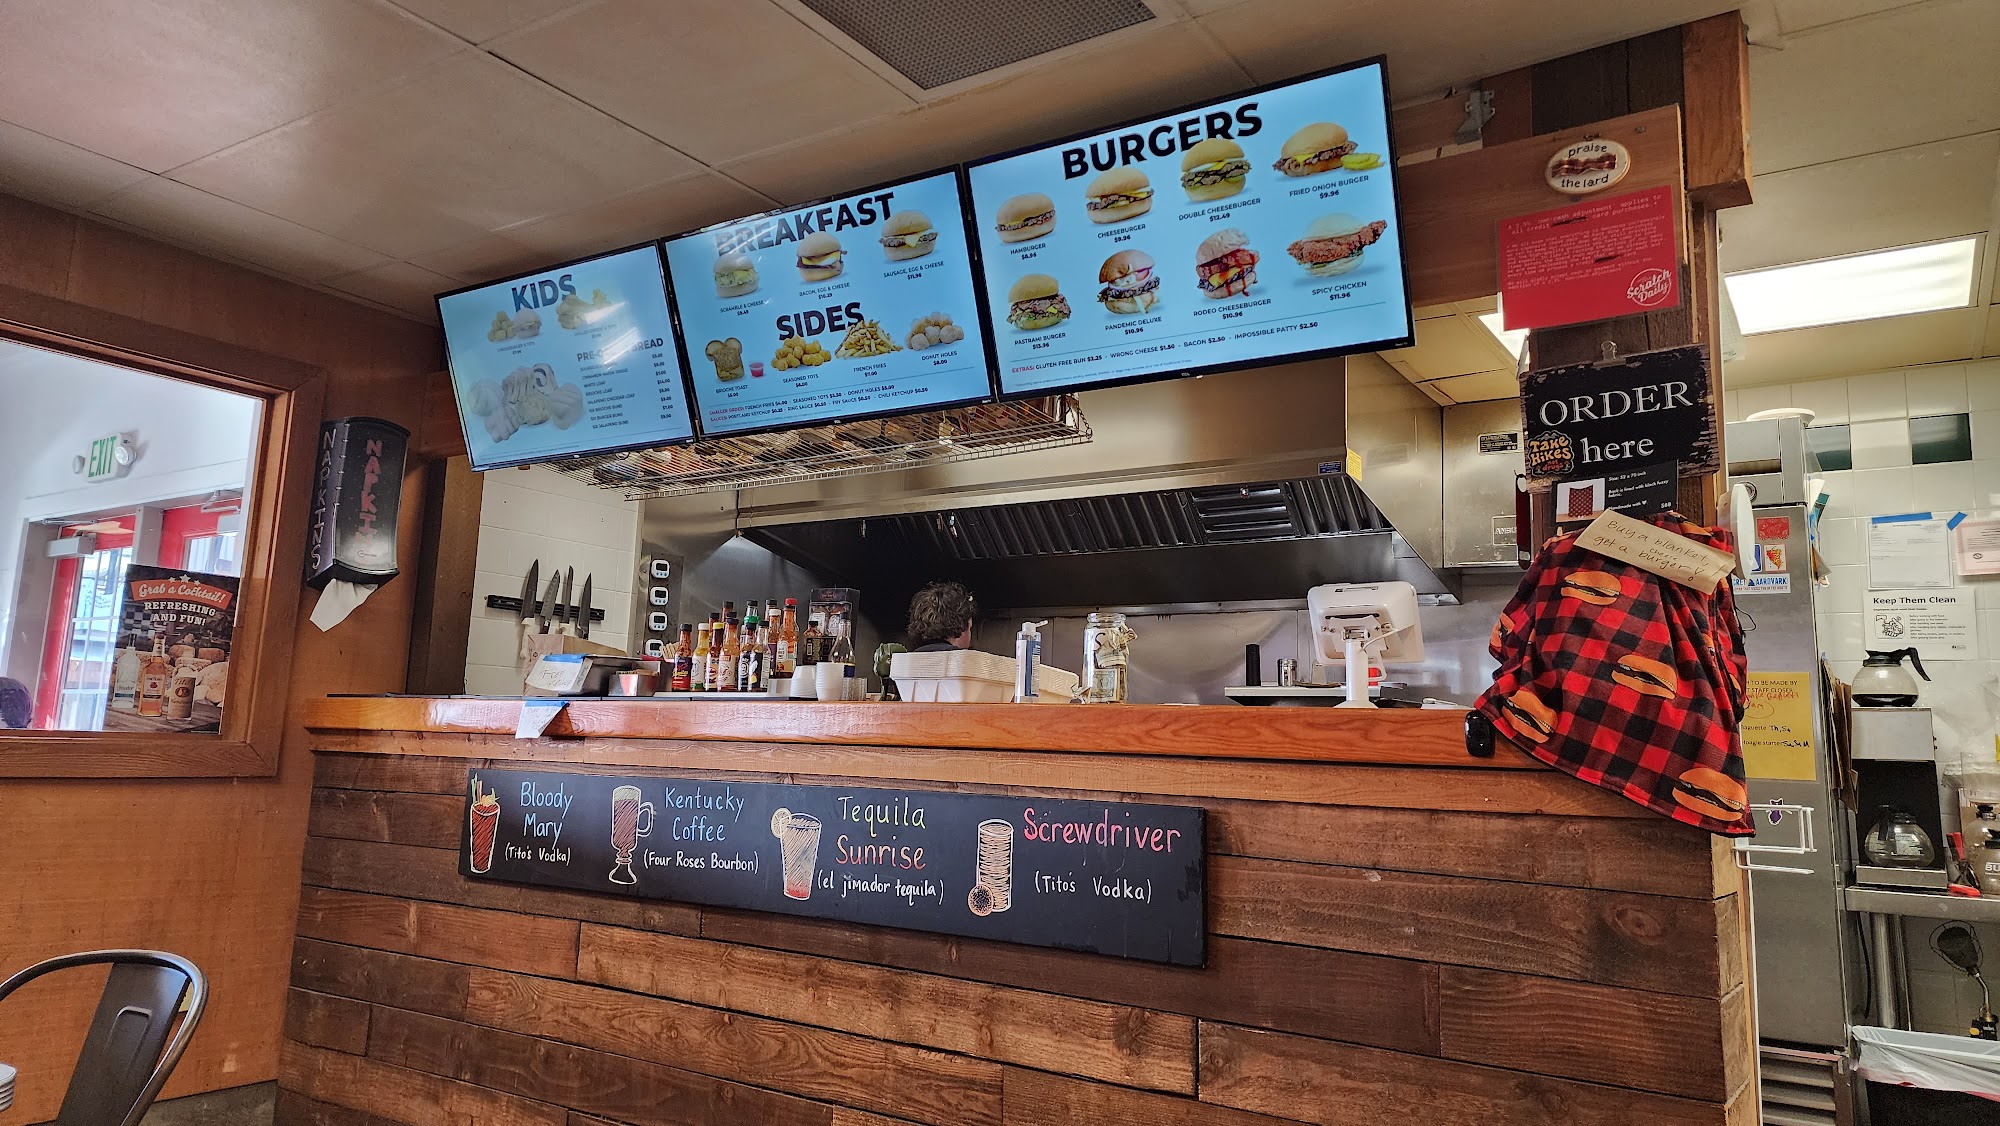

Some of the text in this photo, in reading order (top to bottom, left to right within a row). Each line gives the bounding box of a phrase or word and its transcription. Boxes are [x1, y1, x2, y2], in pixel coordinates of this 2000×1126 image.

[1062, 102, 1263, 180] BURGERS
[1568, 144, 1608, 158] praise
[1289, 175, 1369, 198] FRIED ONION BURGER
[1562, 174, 1610, 188] the lard
[1179, 198, 1261, 221] DOUBLE CHEESEBURGER
[715, 191, 895, 256] BREAKFAST
[1098, 224, 1146, 238] CHEESEBURGER
[1010, 243, 1046, 255] HAMBURGER
[924, 261, 944, 270] CHEESE
[511, 274, 577, 313] KIDS
[832, 282, 850, 291] CHEESE
[1312, 281, 1367, 296] SPICY CHICKEN
[1626, 269, 1672, 299] Scratch
[1637, 281, 1669, 303] Daily
[1193, 299, 1272, 317] RODEO CHEESEBURGER
[776, 302, 864, 341] SIDES
[1105, 316, 1162, 331] PANDEMIC DELUXE
[1014, 332, 1066, 346] PASTRAMI BURGER
[1036, 361, 1058, 370] GLUTEN
[1110, 350, 1134, 359] WRONG
[1135, 347, 1159, 355] CHEESE
[1184, 339, 1207, 348] BACON
[1208, 336, 1226, 344] $2.50
[1235, 328, 1275, 340] IMPOSSIBLE
[1276, 325, 1298, 334] PATTY
[1540, 381, 1694, 426] ORDER
[88, 436, 117, 478] EXIT
[1580, 437, 1654, 464] here
[311, 428, 336, 570] NAPKINS
[1607, 520, 1636, 539] Buy
[1639, 534, 1649, 542] a
[1594, 536, 1616, 547] get
[1619, 546, 1628, 554] a
[138, 583, 226, 602] Grab a Cocktail!
[144, 602, 216, 616] REFRESHING
[152, 614, 206, 626] AND FUN!
[520, 781, 574, 819] Bloody
[665, 787, 744, 822] Kentucky
[672, 817, 726, 842] Coffee
[837, 796, 926, 838] Tequila
[524, 814, 563, 850] Mary
[1024, 808, 1181, 853] Screwdriver
[505, 842, 571, 866] (Tito's Vodka)
[643, 848, 759, 874] (Four Roses Bourbon)
[835, 834, 926, 870] Sunrise
[817, 868, 944, 906] (el jimador tequila)
[1092, 877, 1152, 904] Vodka)
